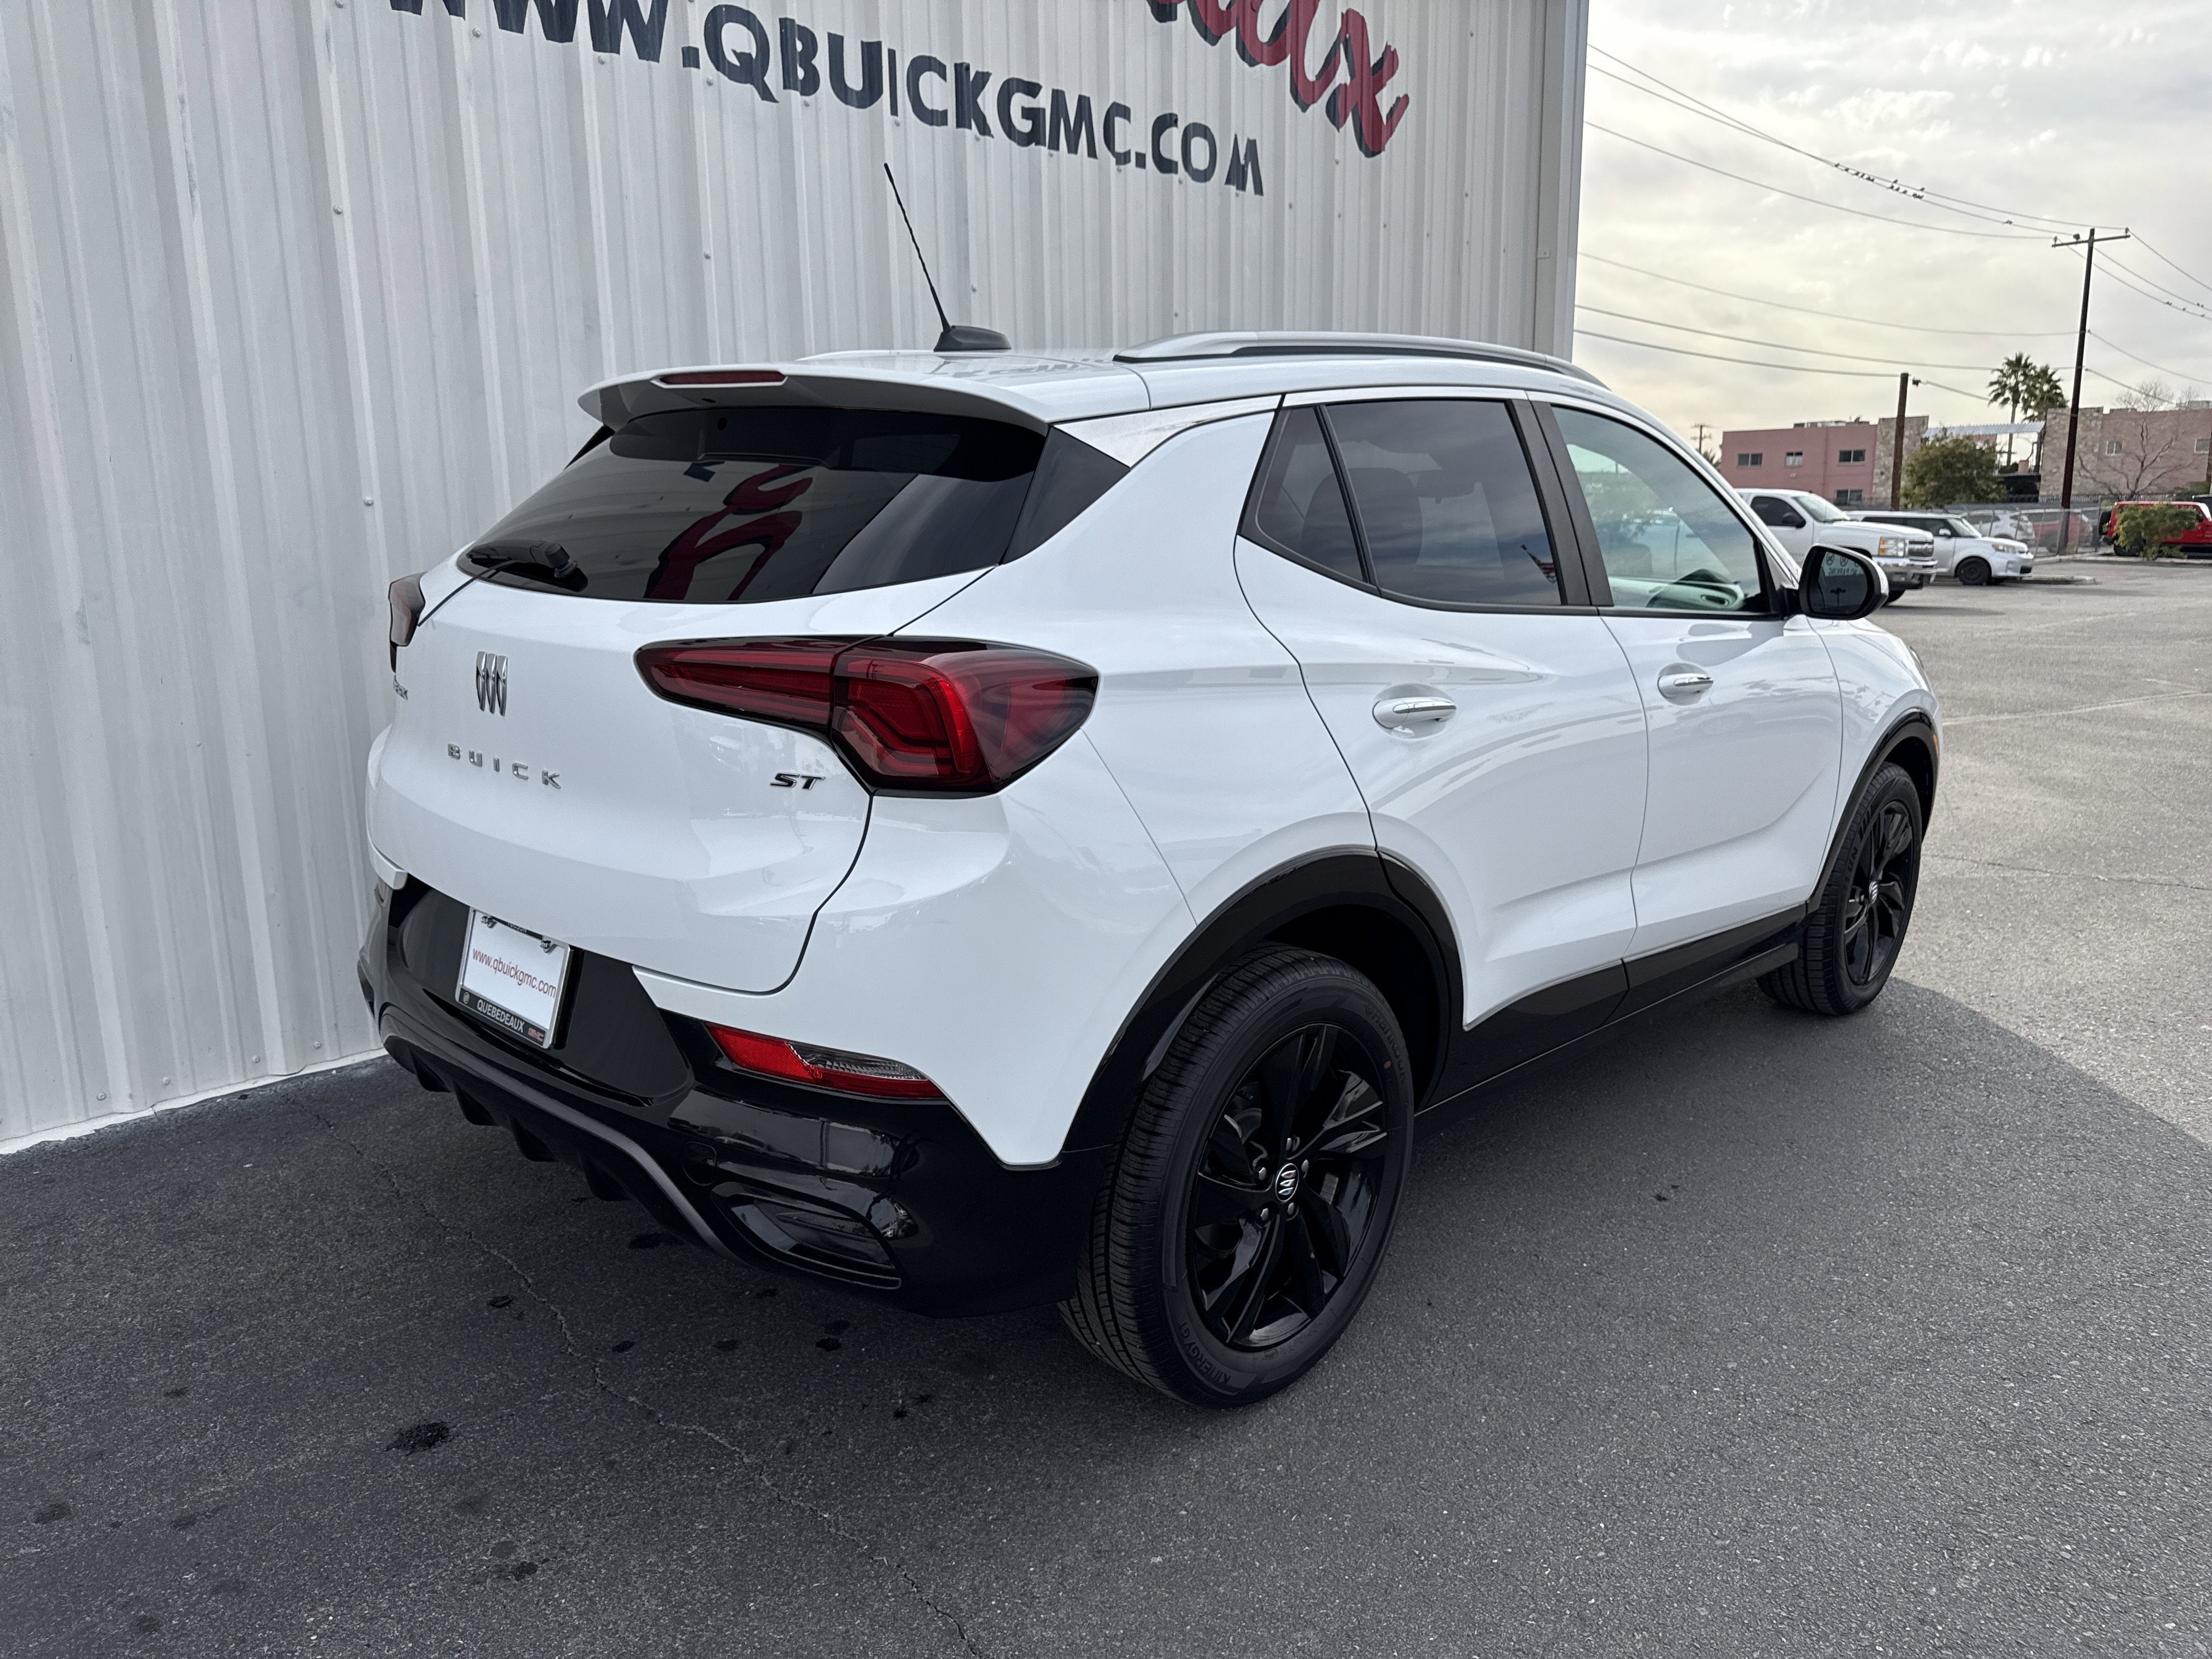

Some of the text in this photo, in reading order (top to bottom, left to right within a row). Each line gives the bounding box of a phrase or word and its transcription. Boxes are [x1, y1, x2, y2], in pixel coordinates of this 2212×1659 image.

[390, 0, 1264, 196] W.QBUICKGMC.COM
[448, 743, 561, 789] BUICK
[770, 772, 826, 790] ST
[472, 948, 557, 998] www.qbuickgmc.com
[477, 999, 525, 1033] QUEBEDEAUX
